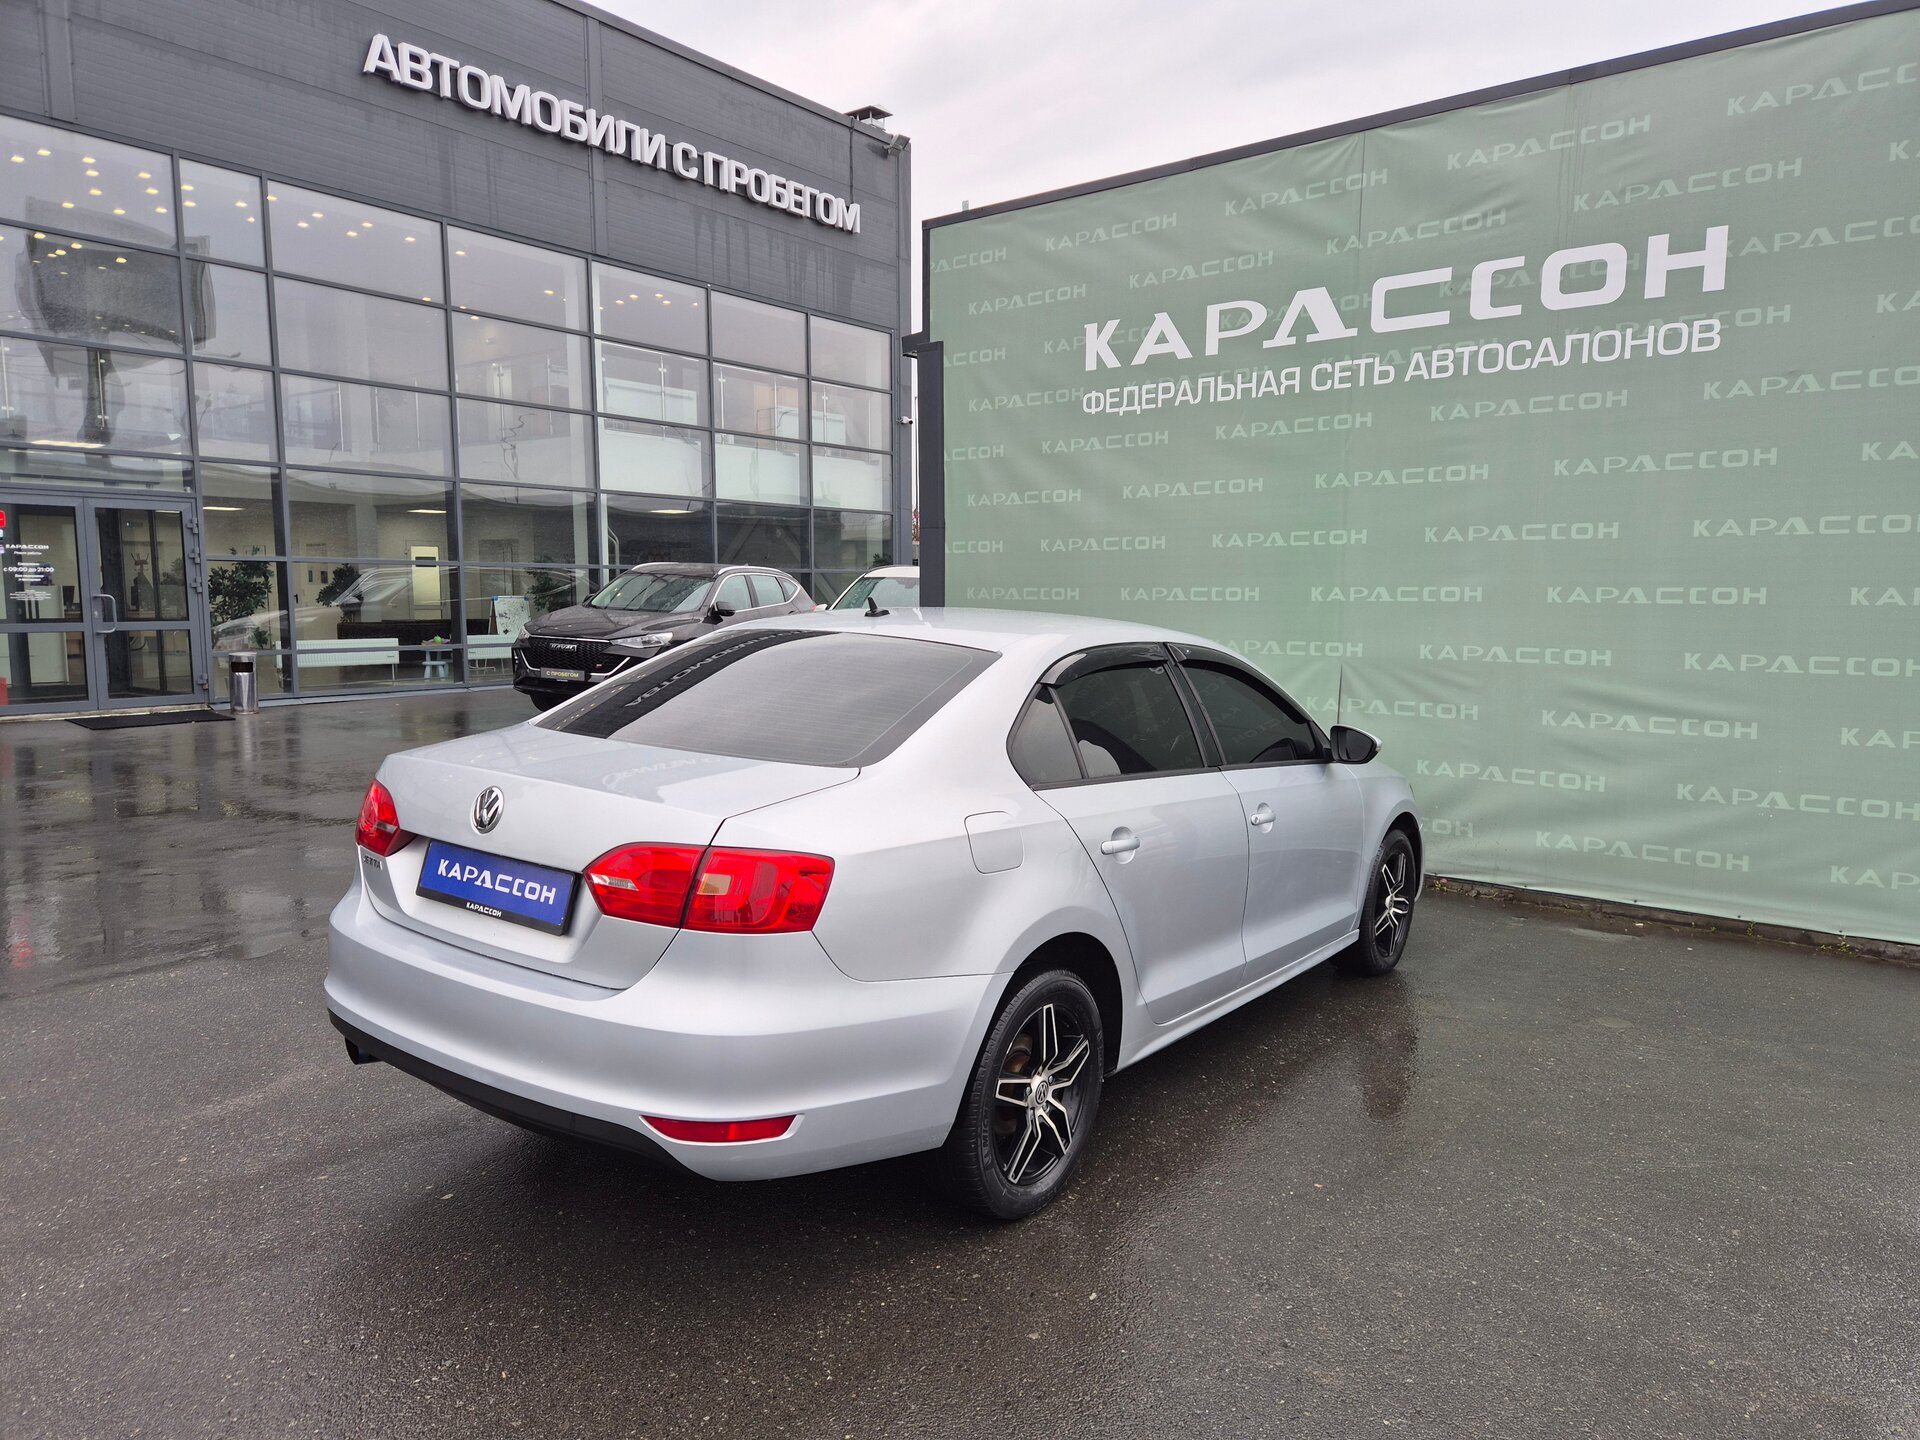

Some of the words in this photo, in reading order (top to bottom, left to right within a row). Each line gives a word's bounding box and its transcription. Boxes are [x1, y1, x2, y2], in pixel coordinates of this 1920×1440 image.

[363, 33, 667, 169] АВТОМОБИЛИ
[673, 142, 698, 179] С
[703, 151, 861, 234] ПРОБЕГОМ
[1084, 224, 1729, 371] КАРАССОН
[1082, 366, 1301, 416] ФЕДЕРАЛЬНАЯ
[1311, 357, 1395, 393] СЕТЬ
[1404, 318, 1721, 382] АВТОСАЛОНОВ
[437, 858, 557, 905] КАРАССОН
